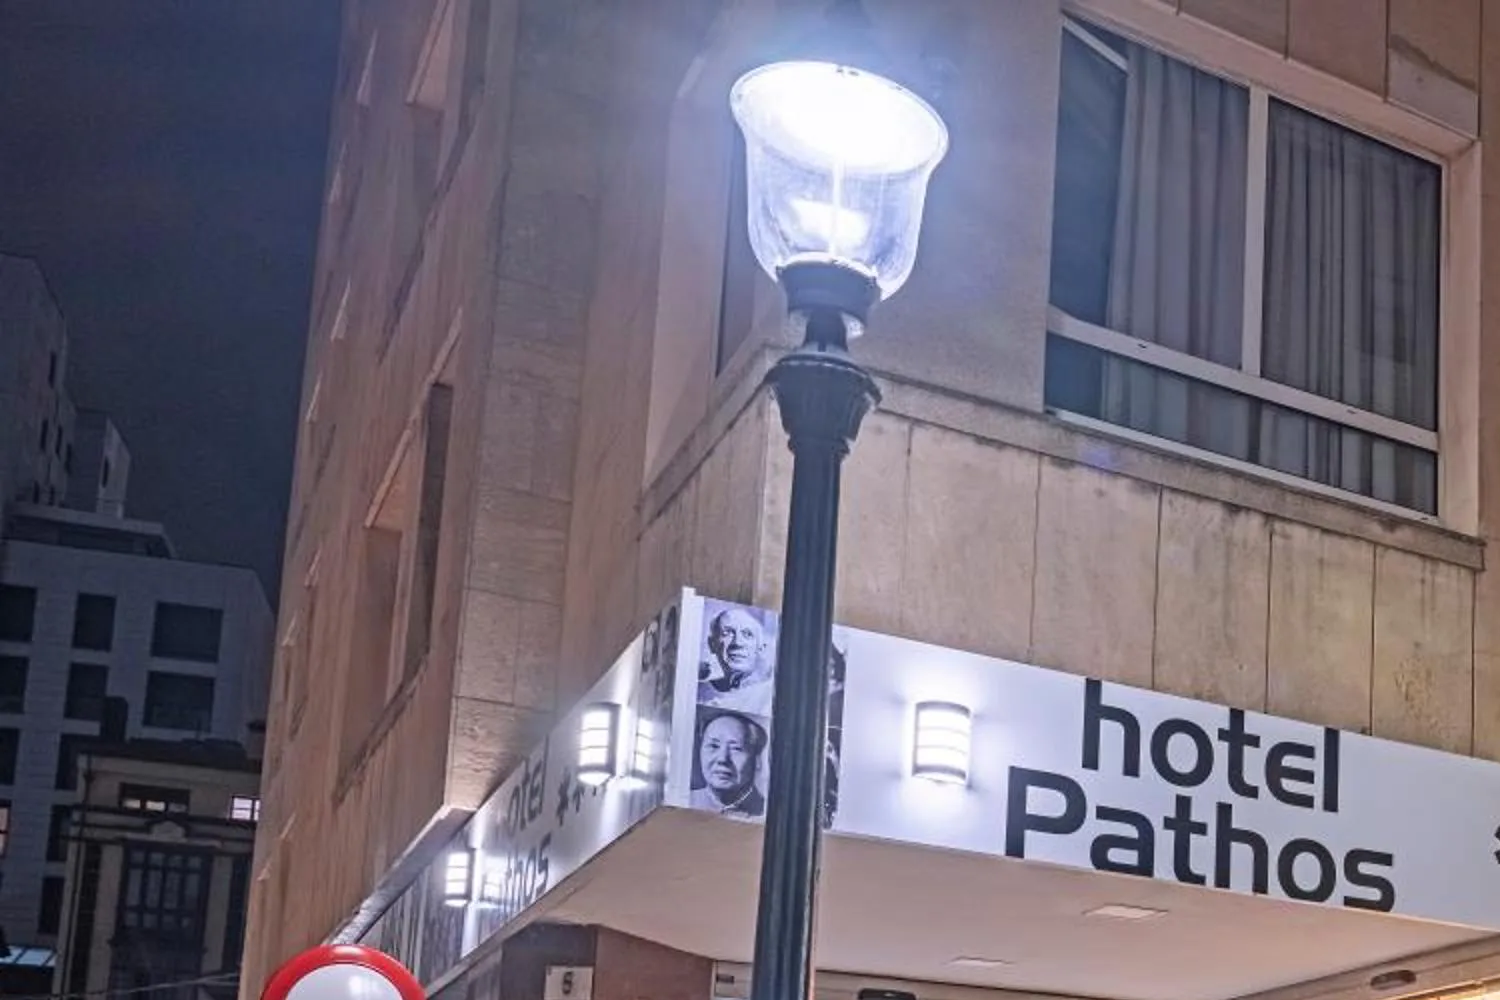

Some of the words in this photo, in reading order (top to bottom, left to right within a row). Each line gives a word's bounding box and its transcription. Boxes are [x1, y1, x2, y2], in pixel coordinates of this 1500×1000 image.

[503, 734, 550, 838] otel
[1082, 678, 1340, 812] hotel
[1005, 765, 1395, 912] Pathos
